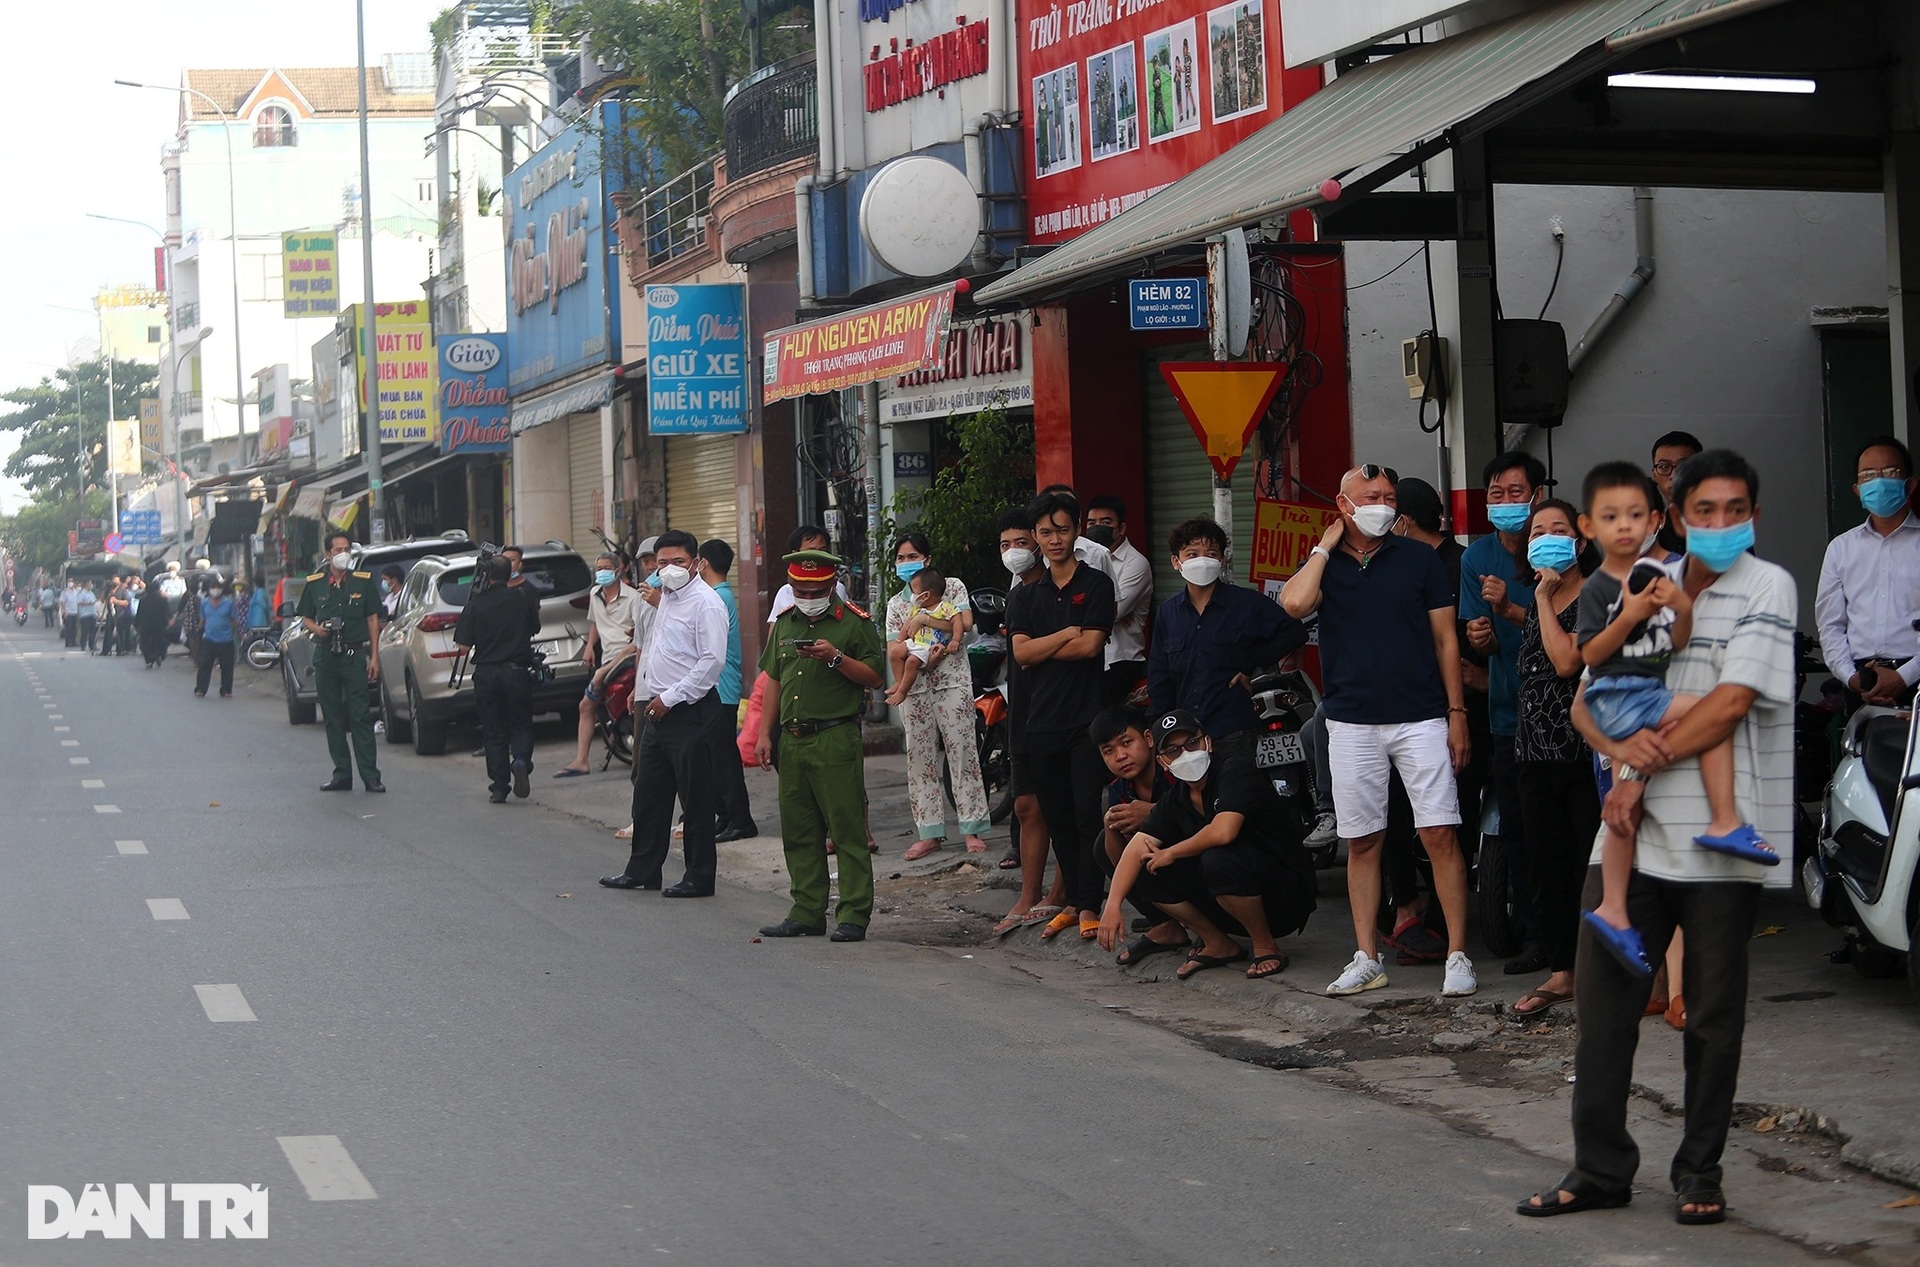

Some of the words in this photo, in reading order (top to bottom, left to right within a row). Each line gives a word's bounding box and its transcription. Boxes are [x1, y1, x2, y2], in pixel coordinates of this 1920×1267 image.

[1030, 3, 1062, 52] THỜI
[1067, 0, 1112, 38] TRANG
[1139, 284, 1171, 300] HẺM
[1175, 286, 1191, 300] 82
[1160, 303, 1168, 311] LÃO
[783, 329, 814, 361] HUY
[818, 313, 879, 354] NGUYEN
[882, 299, 932, 338] ARMY
[377, 331, 402, 355] VẬT
[406, 331, 424, 351] TƯ
[449, 343, 496, 366] Giày
[652, 349, 698, 376] GIỮ
[706, 353, 739, 375] XE
[822, 353, 844, 373] TRANG
[402, 361, 428, 382] LẠNH
[380, 391, 400, 402] MUA
[440, 374, 509, 407] Diễm
[653, 382, 702, 410] MIỄN
[709, 385, 741, 410] PHÍ
[1021, 385, 1030, 399] 08
[403, 426, 426, 440] LẠNH
[898, 454, 927, 469] 86
[1278, 506, 1312, 524] Trà
[1257, 522, 1294, 568] BÚN
[1261, 735, 1297, 751] 59-C2
[1259, 747, 1302, 766] 265.51
